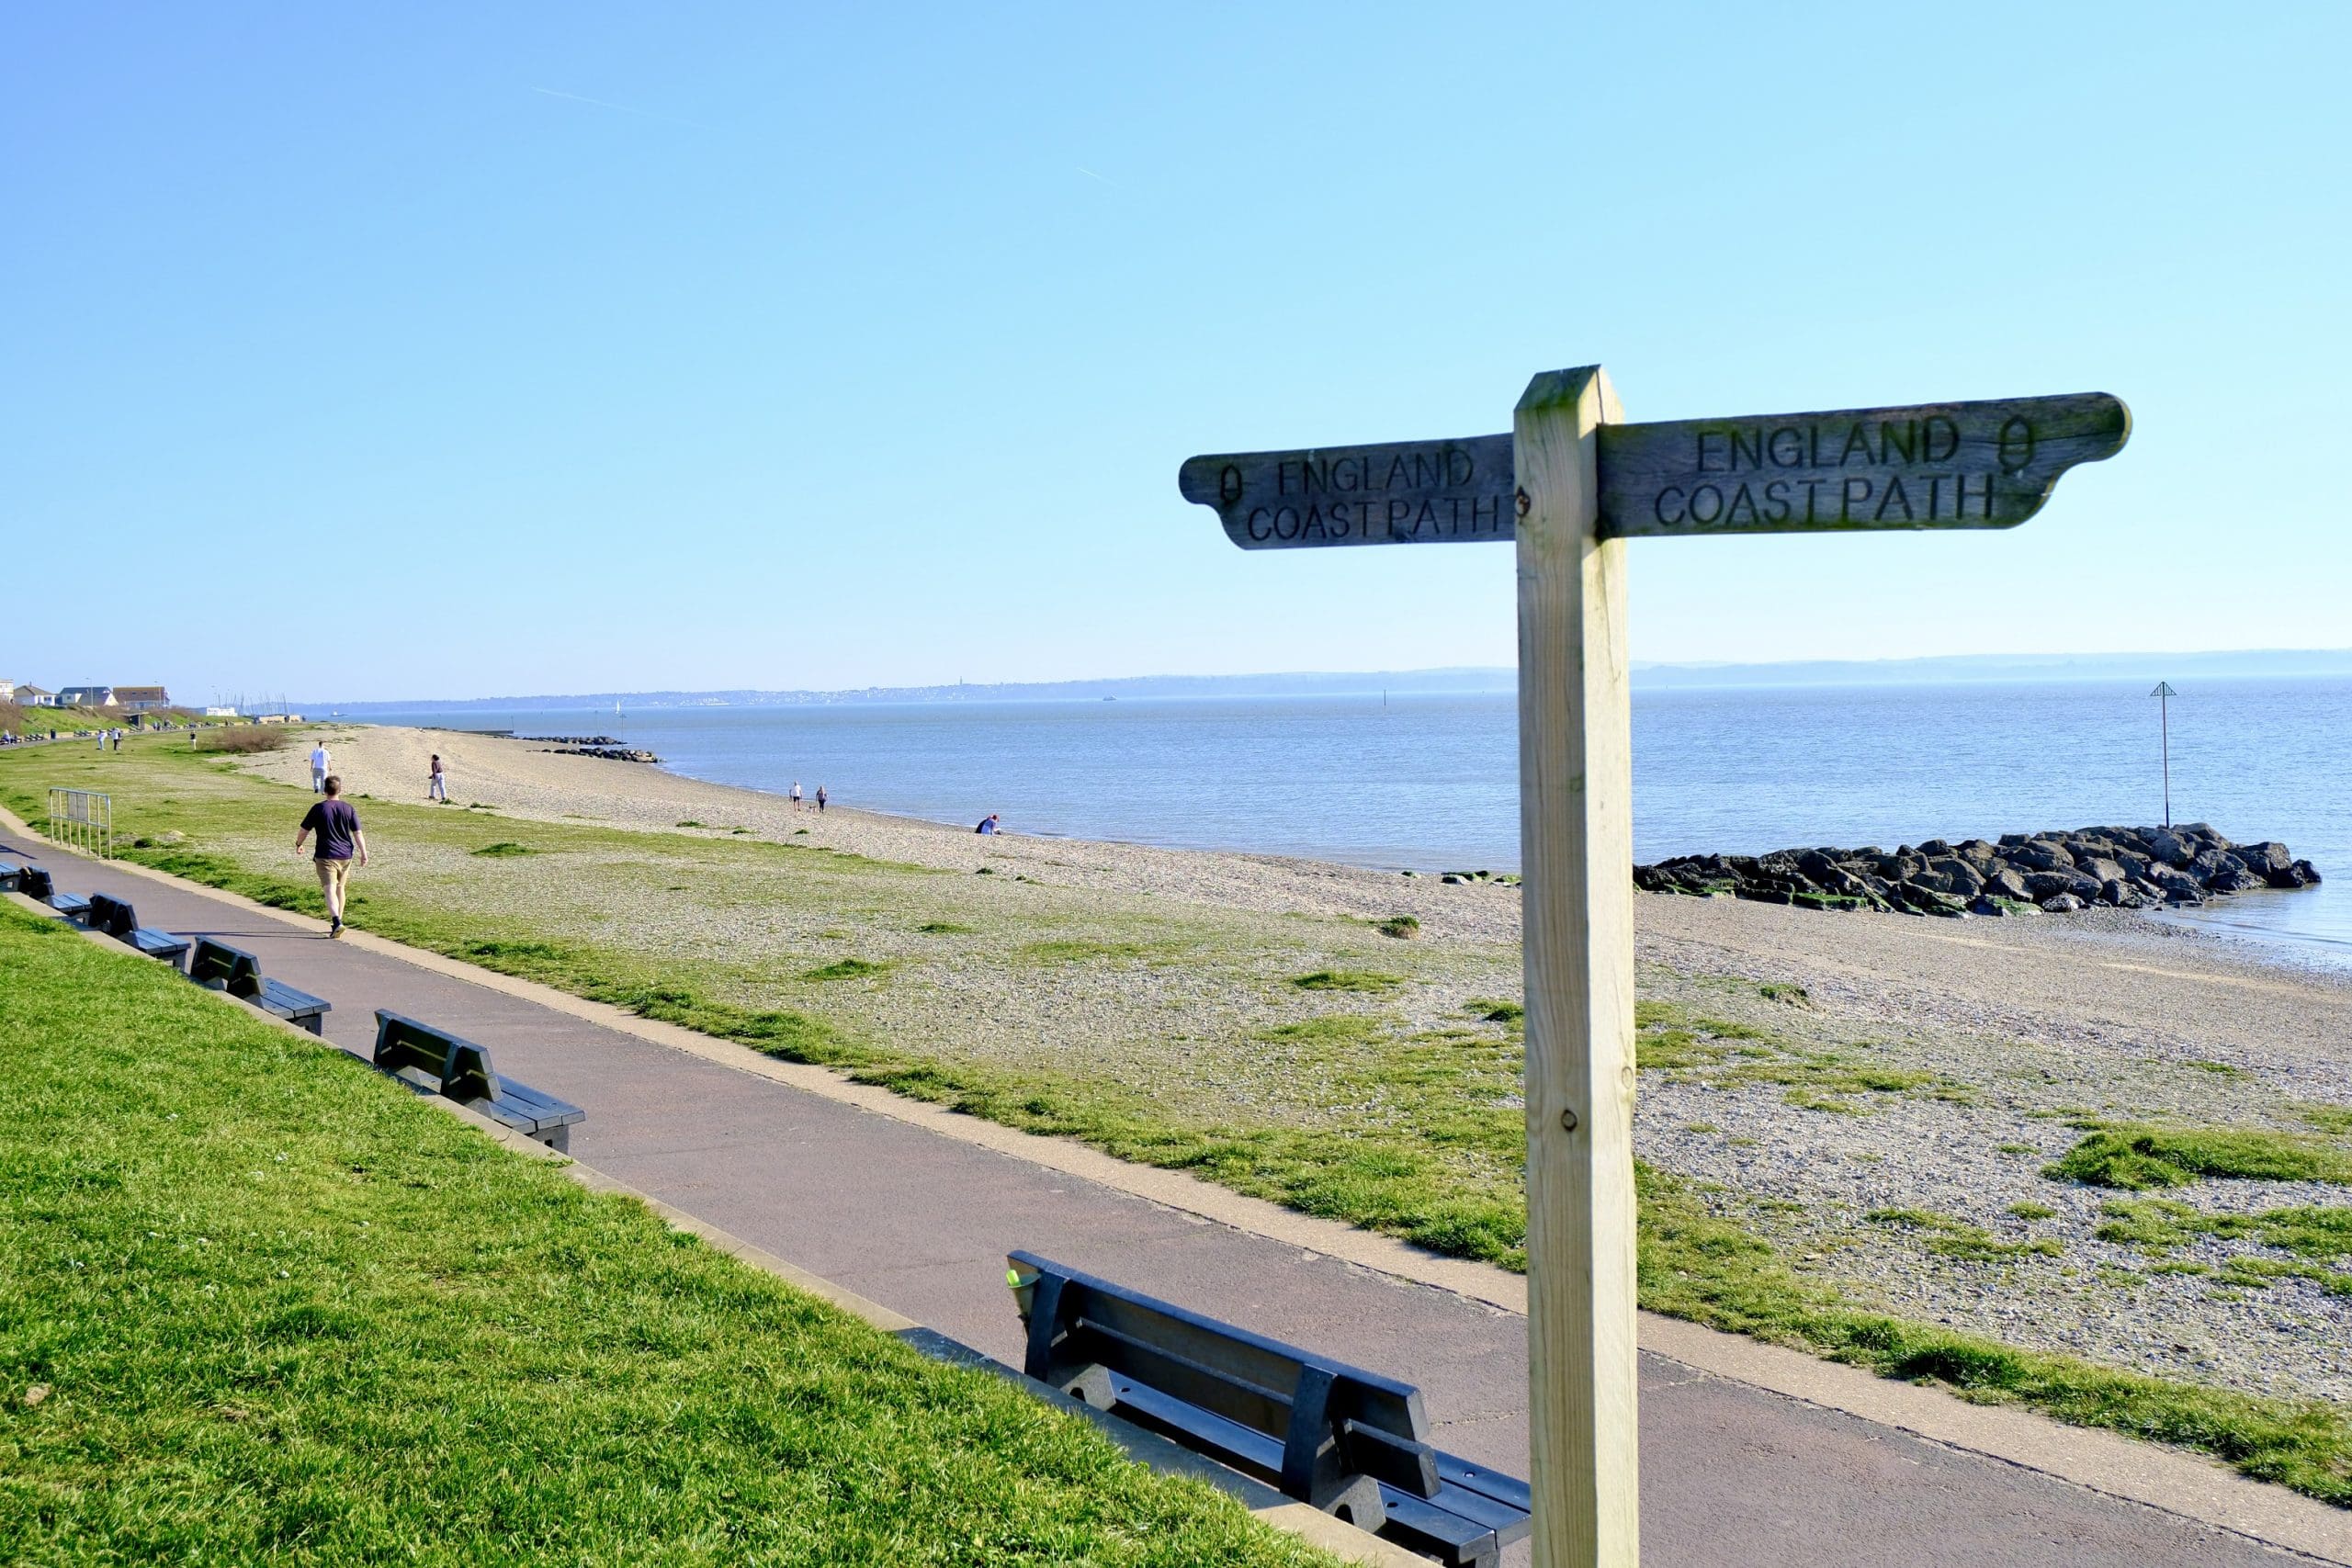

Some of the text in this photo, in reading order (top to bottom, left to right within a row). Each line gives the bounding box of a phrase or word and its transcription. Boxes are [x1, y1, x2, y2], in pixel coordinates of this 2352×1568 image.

[1697, 415, 1960, 472] ENGLAND
[1278, 448, 1474, 496] ENGLAND
[1248, 495, 1498, 542] COAST PATH
[1655, 472, 1993, 527] COAST PATH
